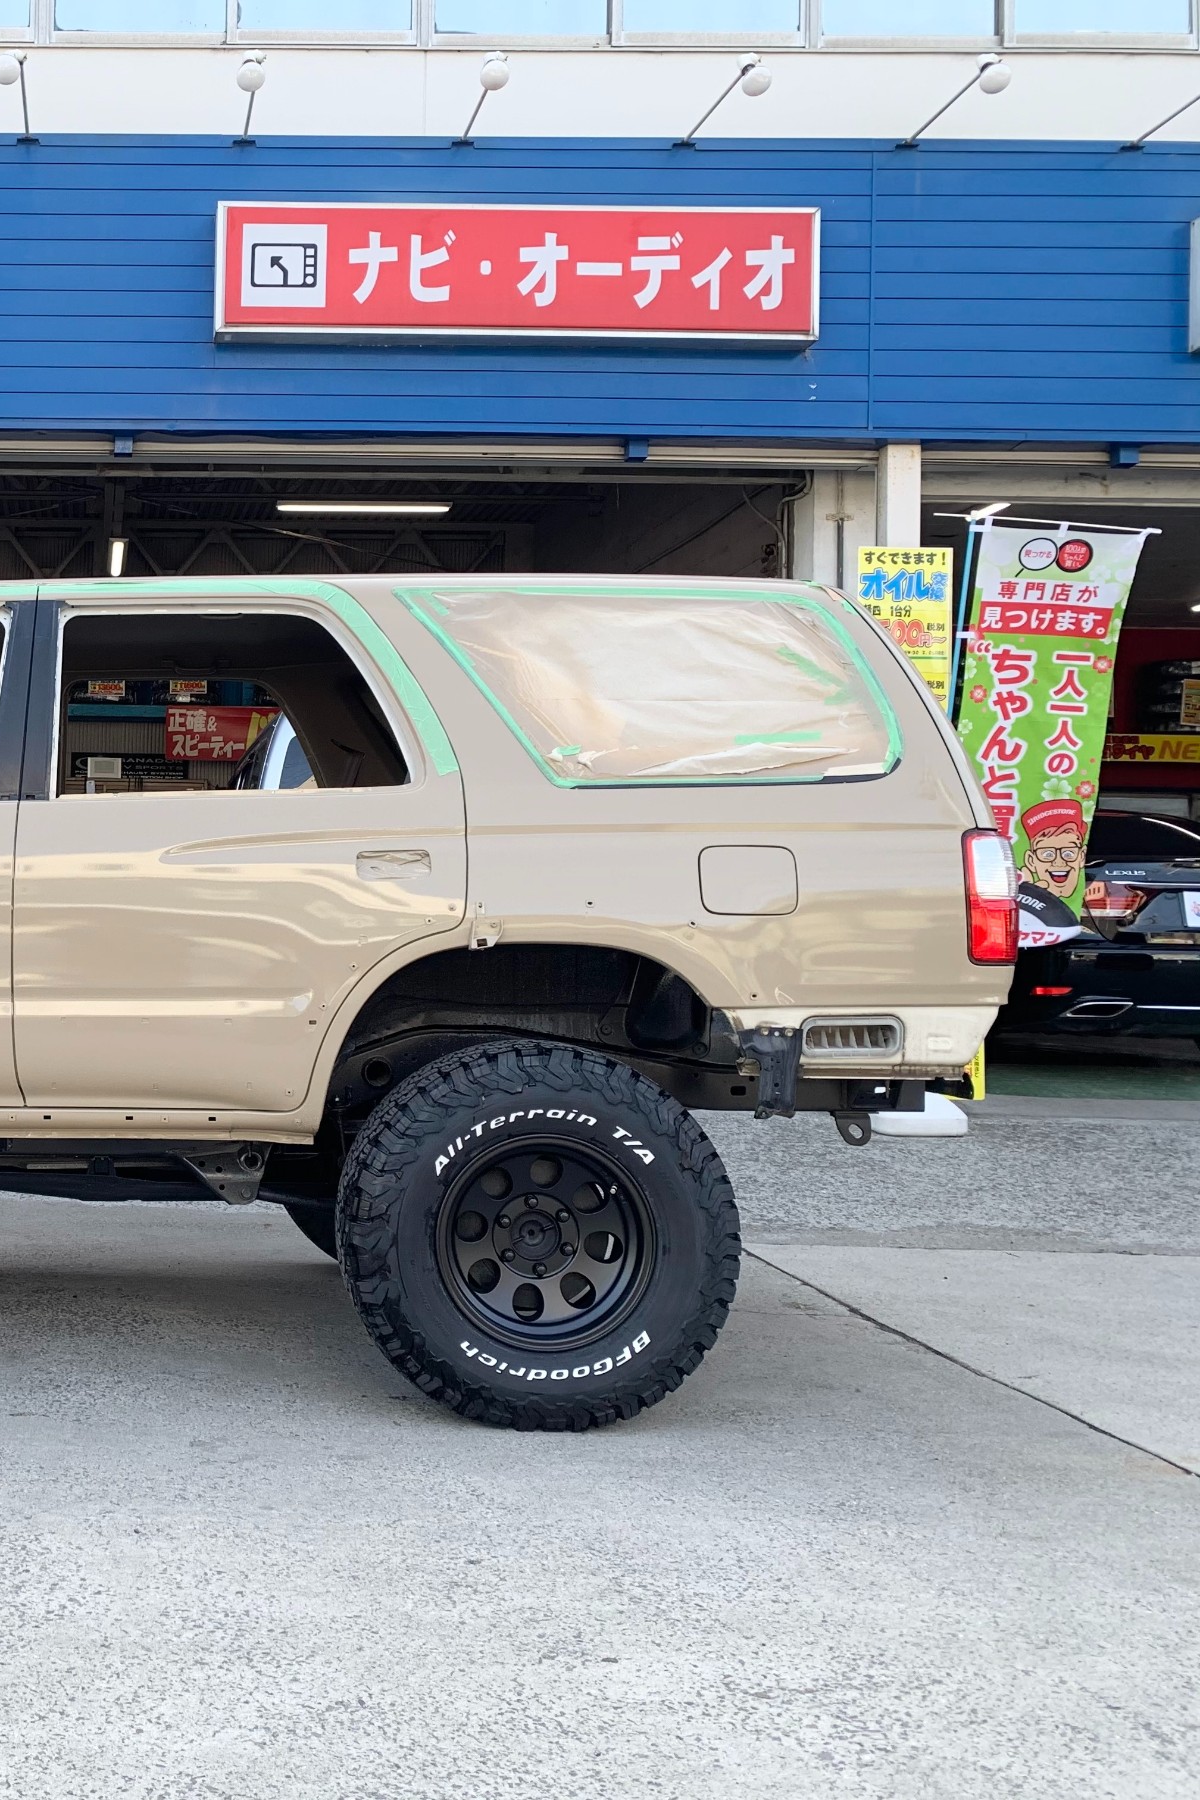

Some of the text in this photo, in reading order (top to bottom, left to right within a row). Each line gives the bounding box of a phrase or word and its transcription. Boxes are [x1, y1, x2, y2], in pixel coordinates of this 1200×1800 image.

[348, 229, 796, 310] ナビ・オーディオ
[863, 550, 947, 566] すぐできます！
[997, 580, 1099, 603] 専門店が
[890, 605, 913, 618] 1台分
[980, 606, 1107, 636] 見つけます。
[1047, 653, 1092, 775] 一人一人の
[172, 734, 245, 758] スピーディー
[611, 1125, 656, 1166] T/A
[459, 1330, 653, 1382] BFGoodrich
